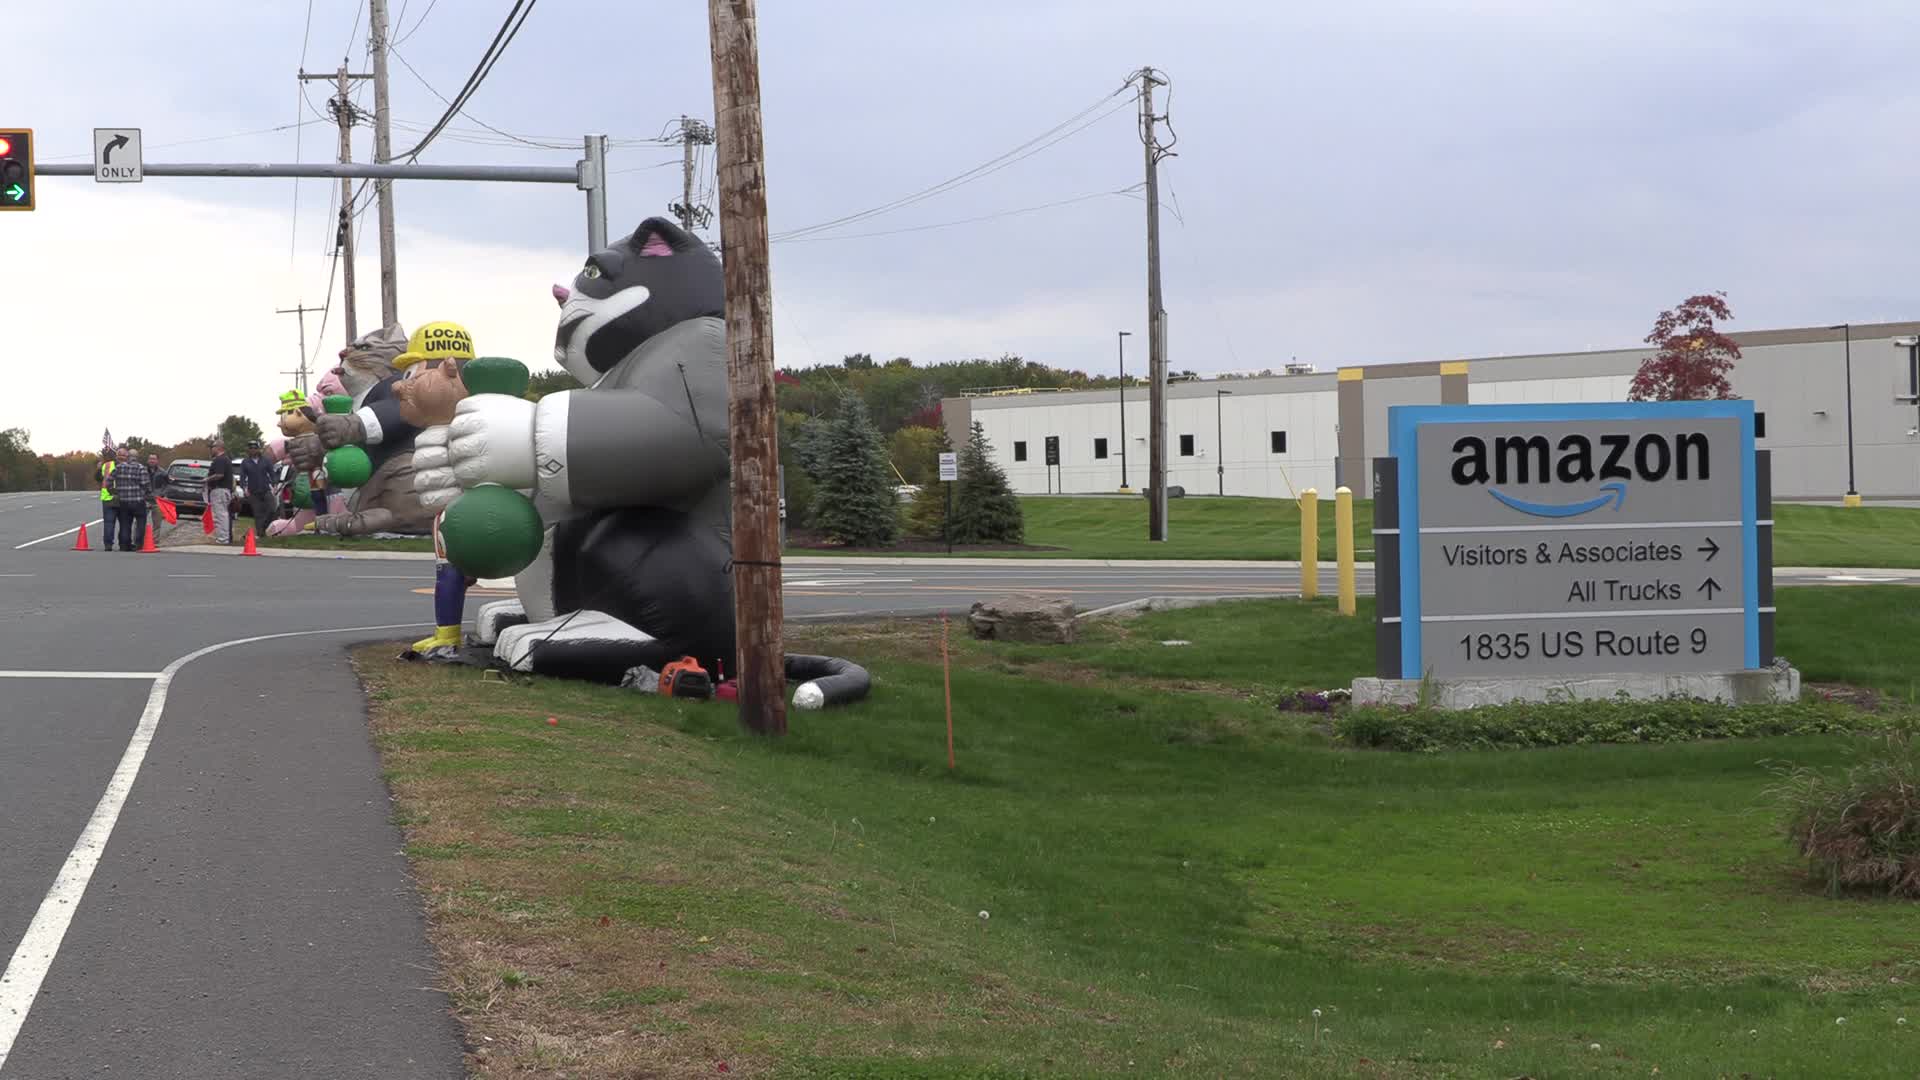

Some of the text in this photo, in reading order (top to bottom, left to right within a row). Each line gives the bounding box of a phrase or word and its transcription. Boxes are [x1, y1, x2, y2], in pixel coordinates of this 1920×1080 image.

[102, 167, 135, 178] ONLY
[424, 329, 471, 342] LOCAL
[425, 340, 471, 353] UNION
[1451, 433, 1710, 486] amazon
[1443, 540, 1683, 567] Visitors & Associates
[1567, 578, 1682, 602] All Trucks
[1460, 628, 1707, 661] 1835 US Route 9
